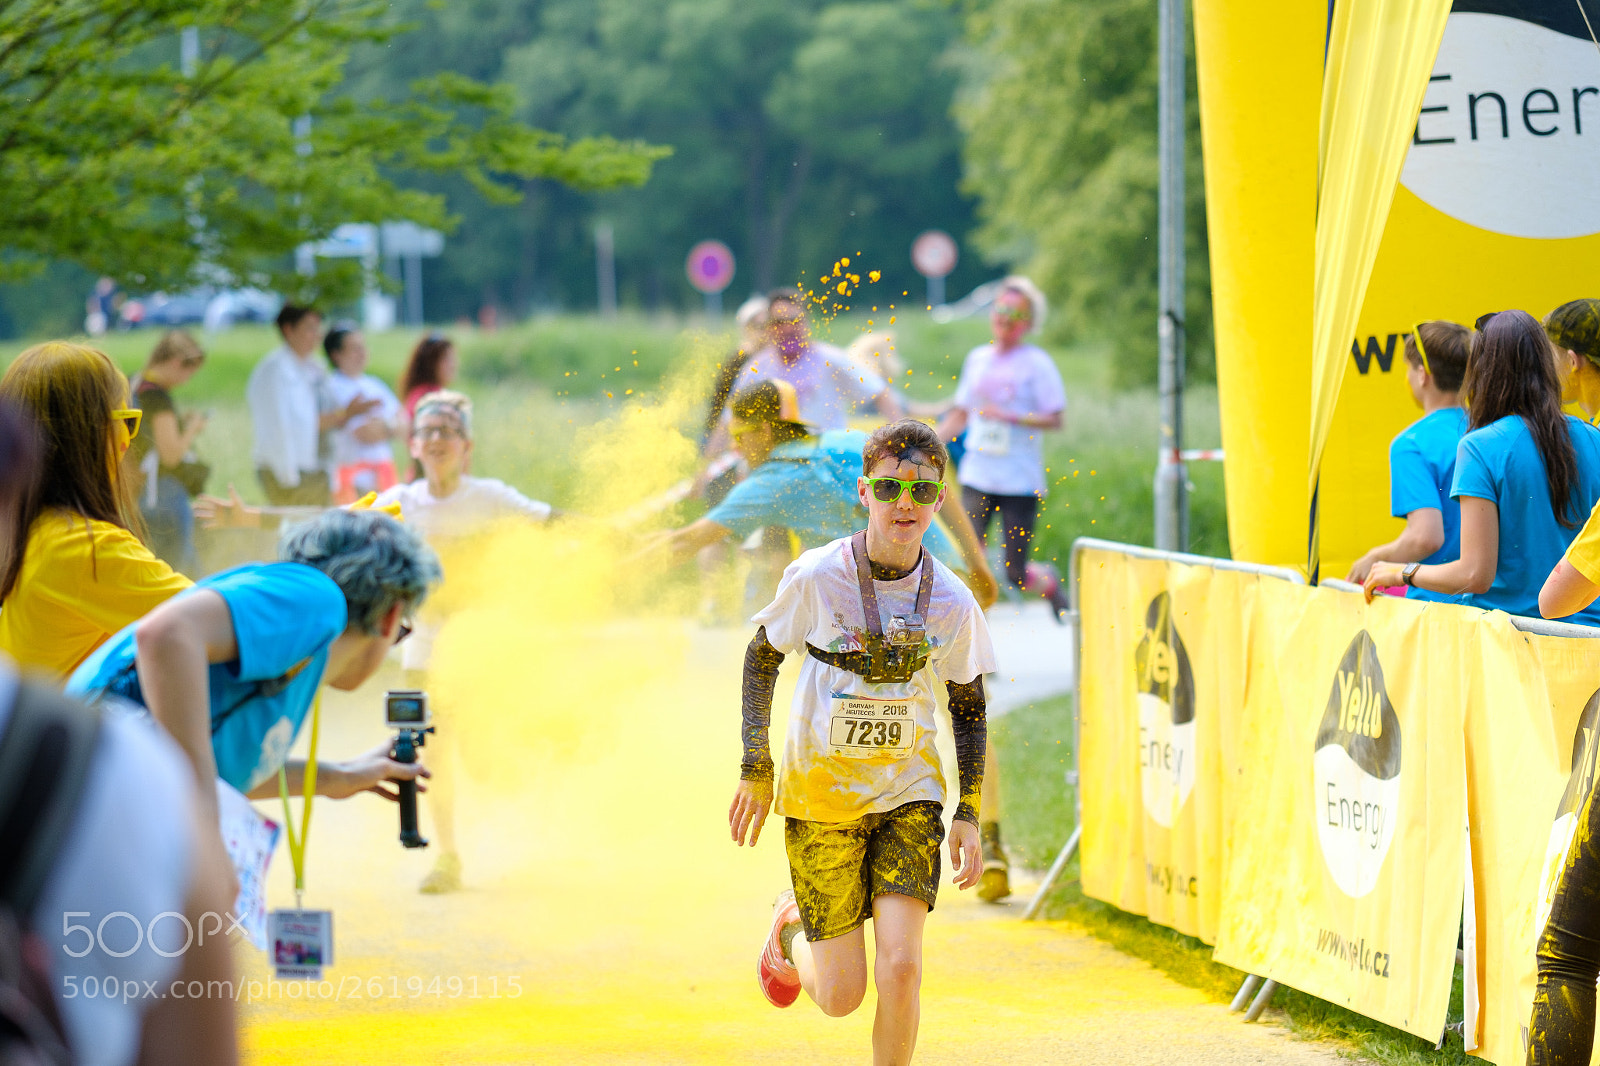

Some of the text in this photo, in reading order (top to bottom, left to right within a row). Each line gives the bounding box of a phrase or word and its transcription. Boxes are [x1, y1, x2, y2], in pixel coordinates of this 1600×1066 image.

[882, 705, 908, 716] 2018
[1338, 670, 1383, 739] Yello
[845, 720, 902, 746] 7239
[1327, 782, 1387, 850] Energy
